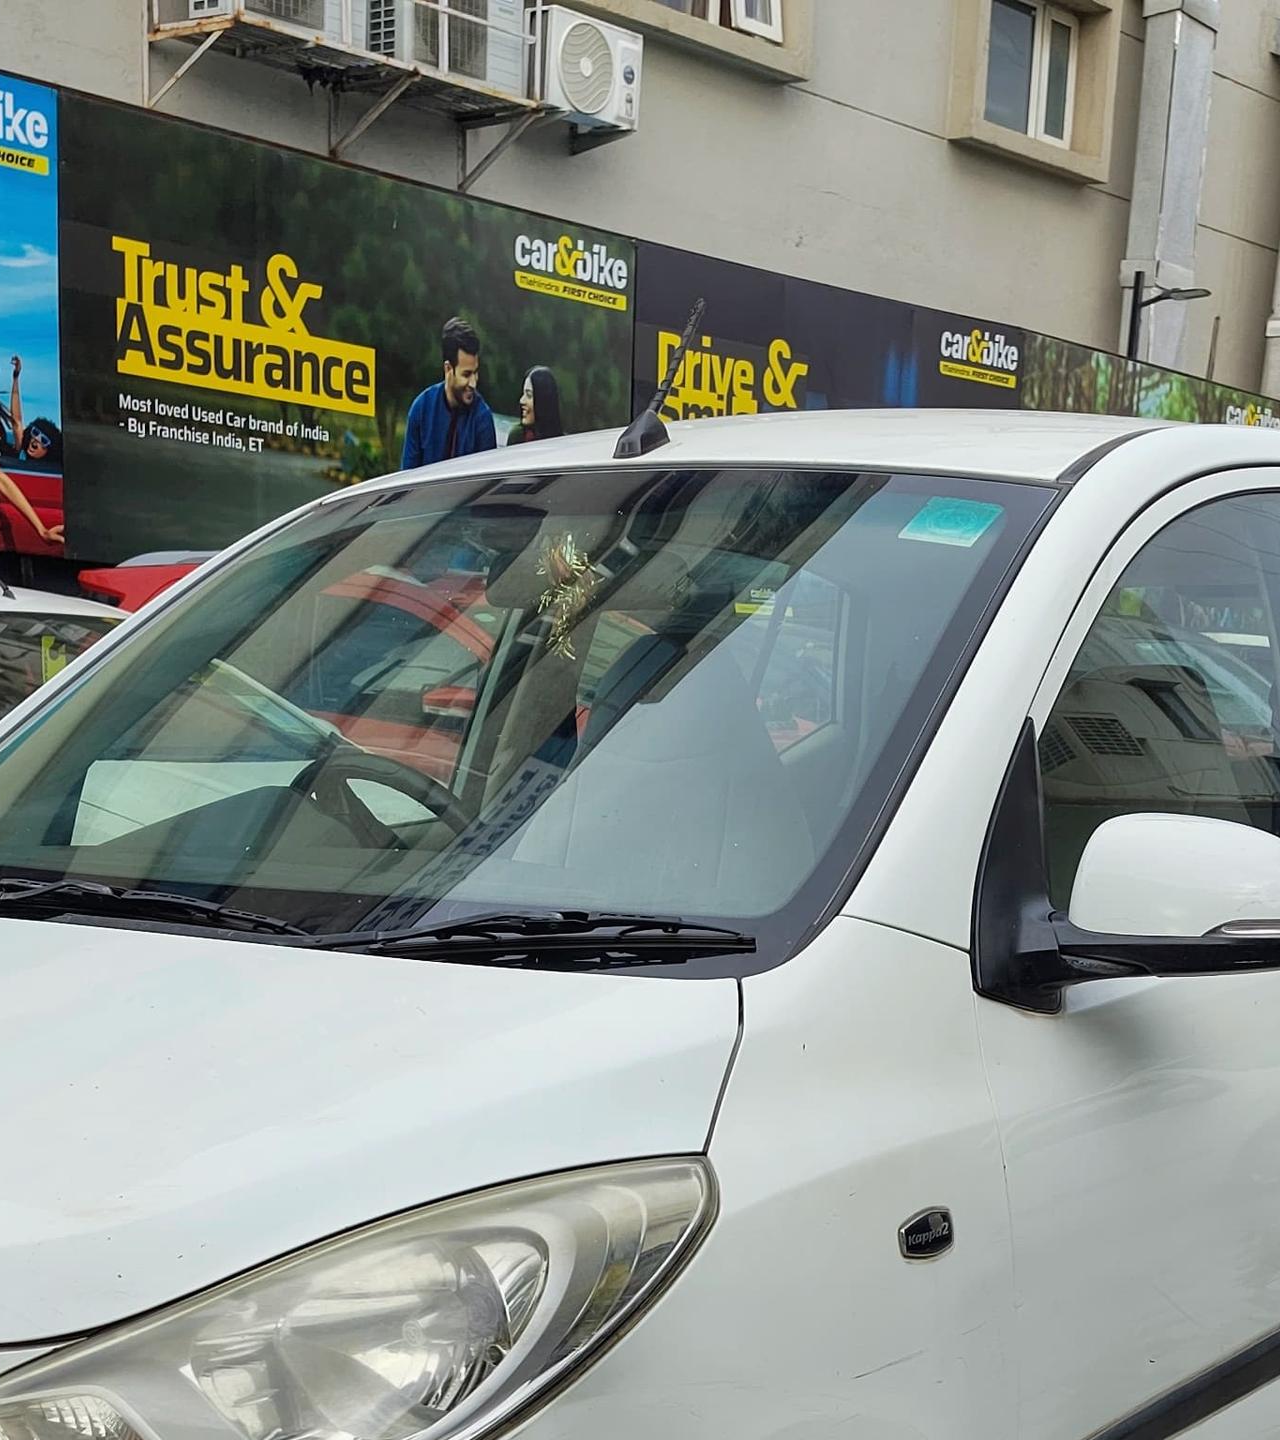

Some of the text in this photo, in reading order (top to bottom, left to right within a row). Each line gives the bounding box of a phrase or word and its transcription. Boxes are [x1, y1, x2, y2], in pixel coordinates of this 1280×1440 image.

[111, 235, 323, 336] Trust &
[515, 234, 628, 290] car&bike
[562, 285, 587, 298] FIRST
[588, 291, 618, 306] CHOICE
[118, 306, 371, 404] Assurance
[658, 331, 754, 397] Drive
[762, 338, 810, 408] &
[940, 329, 1019, 371] car&bike
[118, 393, 330, 442] Most loved Used Car brand of India
[128, 417, 265, 453] By Franchise India, ET
